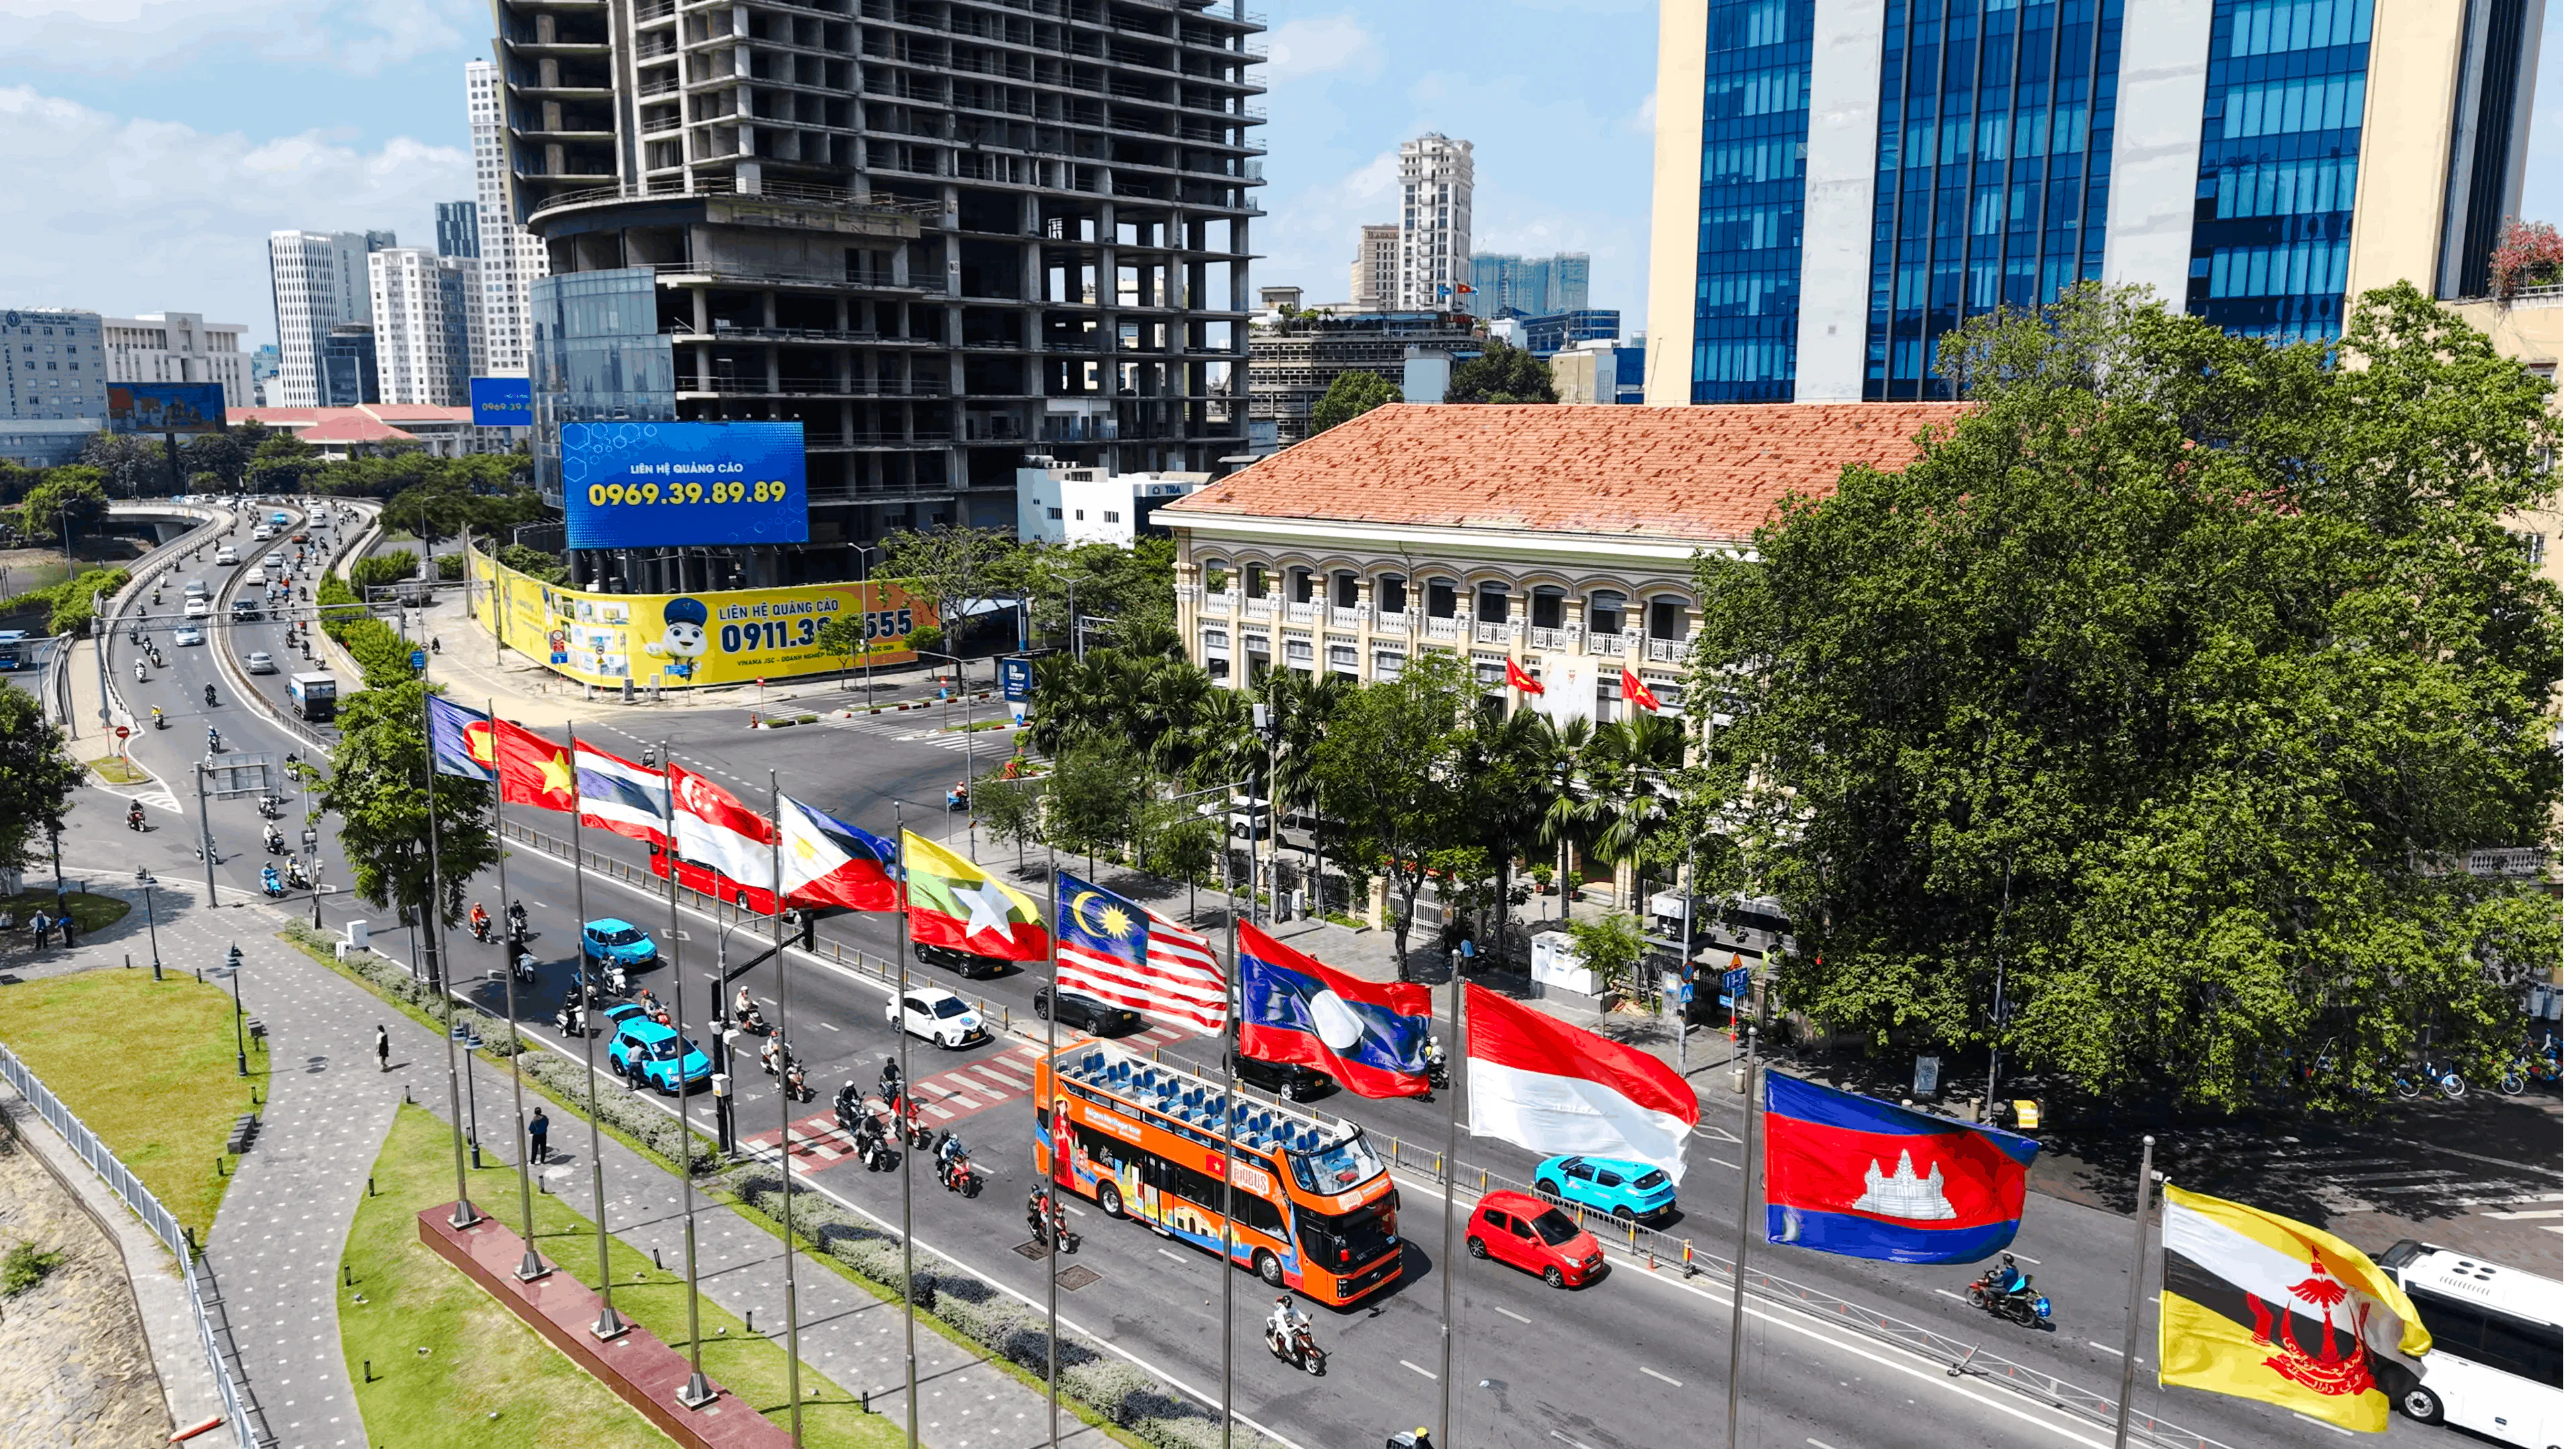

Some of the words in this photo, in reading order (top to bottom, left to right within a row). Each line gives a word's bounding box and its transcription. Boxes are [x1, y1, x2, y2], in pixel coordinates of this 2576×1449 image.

[631, 462, 653, 474] LIÊN
[656, 462, 670, 476] HỆ
[673, 461, 715, 474] QUẢNG
[718, 461, 744, 473] CÁO
[589, 480, 786, 506] 0969.39.89.89
[719, 603, 748, 620] LIÊN
[753, 602, 768, 620] HỆ
[773, 599, 813, 616] QUẢNG
[817, 597, 839, 612] CÁO
